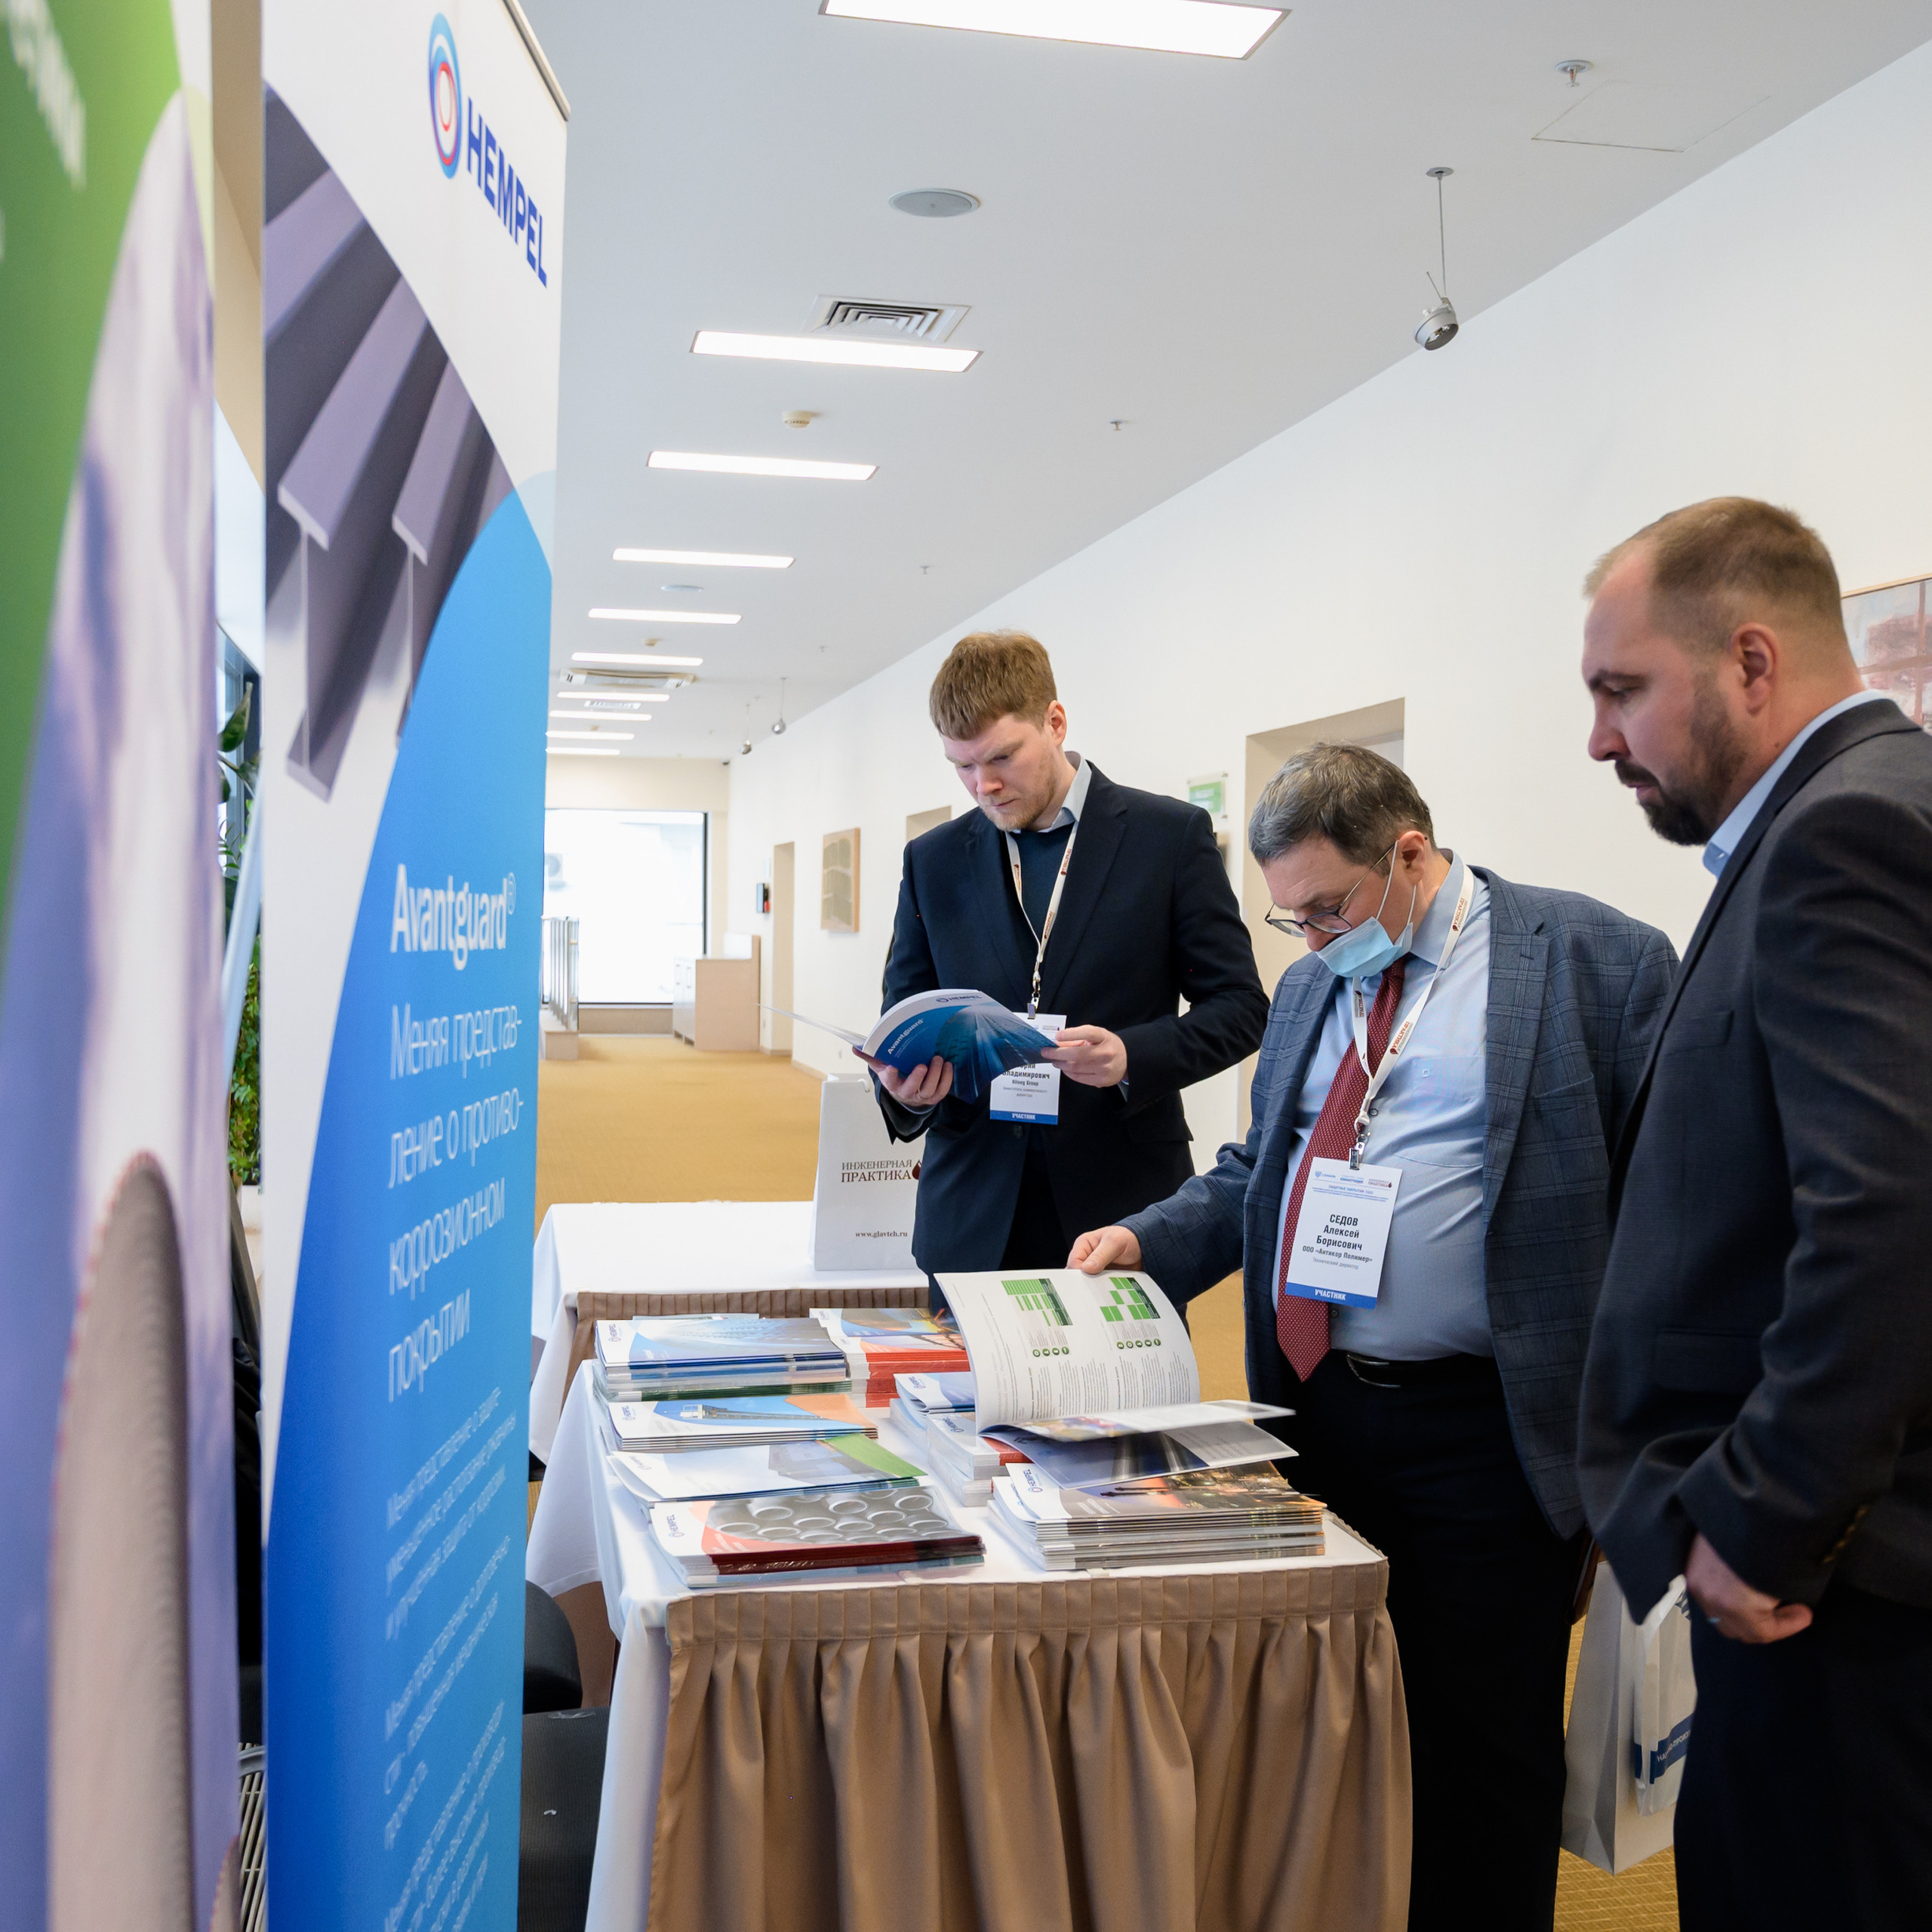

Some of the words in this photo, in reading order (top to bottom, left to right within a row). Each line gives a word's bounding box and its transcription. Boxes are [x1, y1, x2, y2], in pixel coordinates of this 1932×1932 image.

[467, 96, 547, 288] HEMPEL
[390, 1003, 449, 1080] Меняя
[453, 1005, 522, 1078] представ-
[1392, 1021, 1410, 1048] ПРАКТИКА
[389, 1115, 443, 1189] ление
[446, 1109, 459, 1159] о
[462, 1088, 524, 1167] противо-
[841, 1159, 912, 1171] ИНЖЕНЕРНАЯ
[841, 1170, 912, 1183] ПРАКТИКА
[1330, 1214, 1358, 1226] СЕДОВ
[389, 1177, 505, 1301] коррозионном
[855, 1230, 908, 1238] www.glavteh.ru
[1323, 1224, 1360, 1238] Алексей
[1316, 1235, 1362, 1251] Борисович
[1315, 1288, 1346, 1300] УЧАСТНИК
[389, 1287, 470, 1403] покрытии
[1023, 1469, 1036, 1487] HEMPEL
[666, 1514, 678, 1533] HEMPEL
